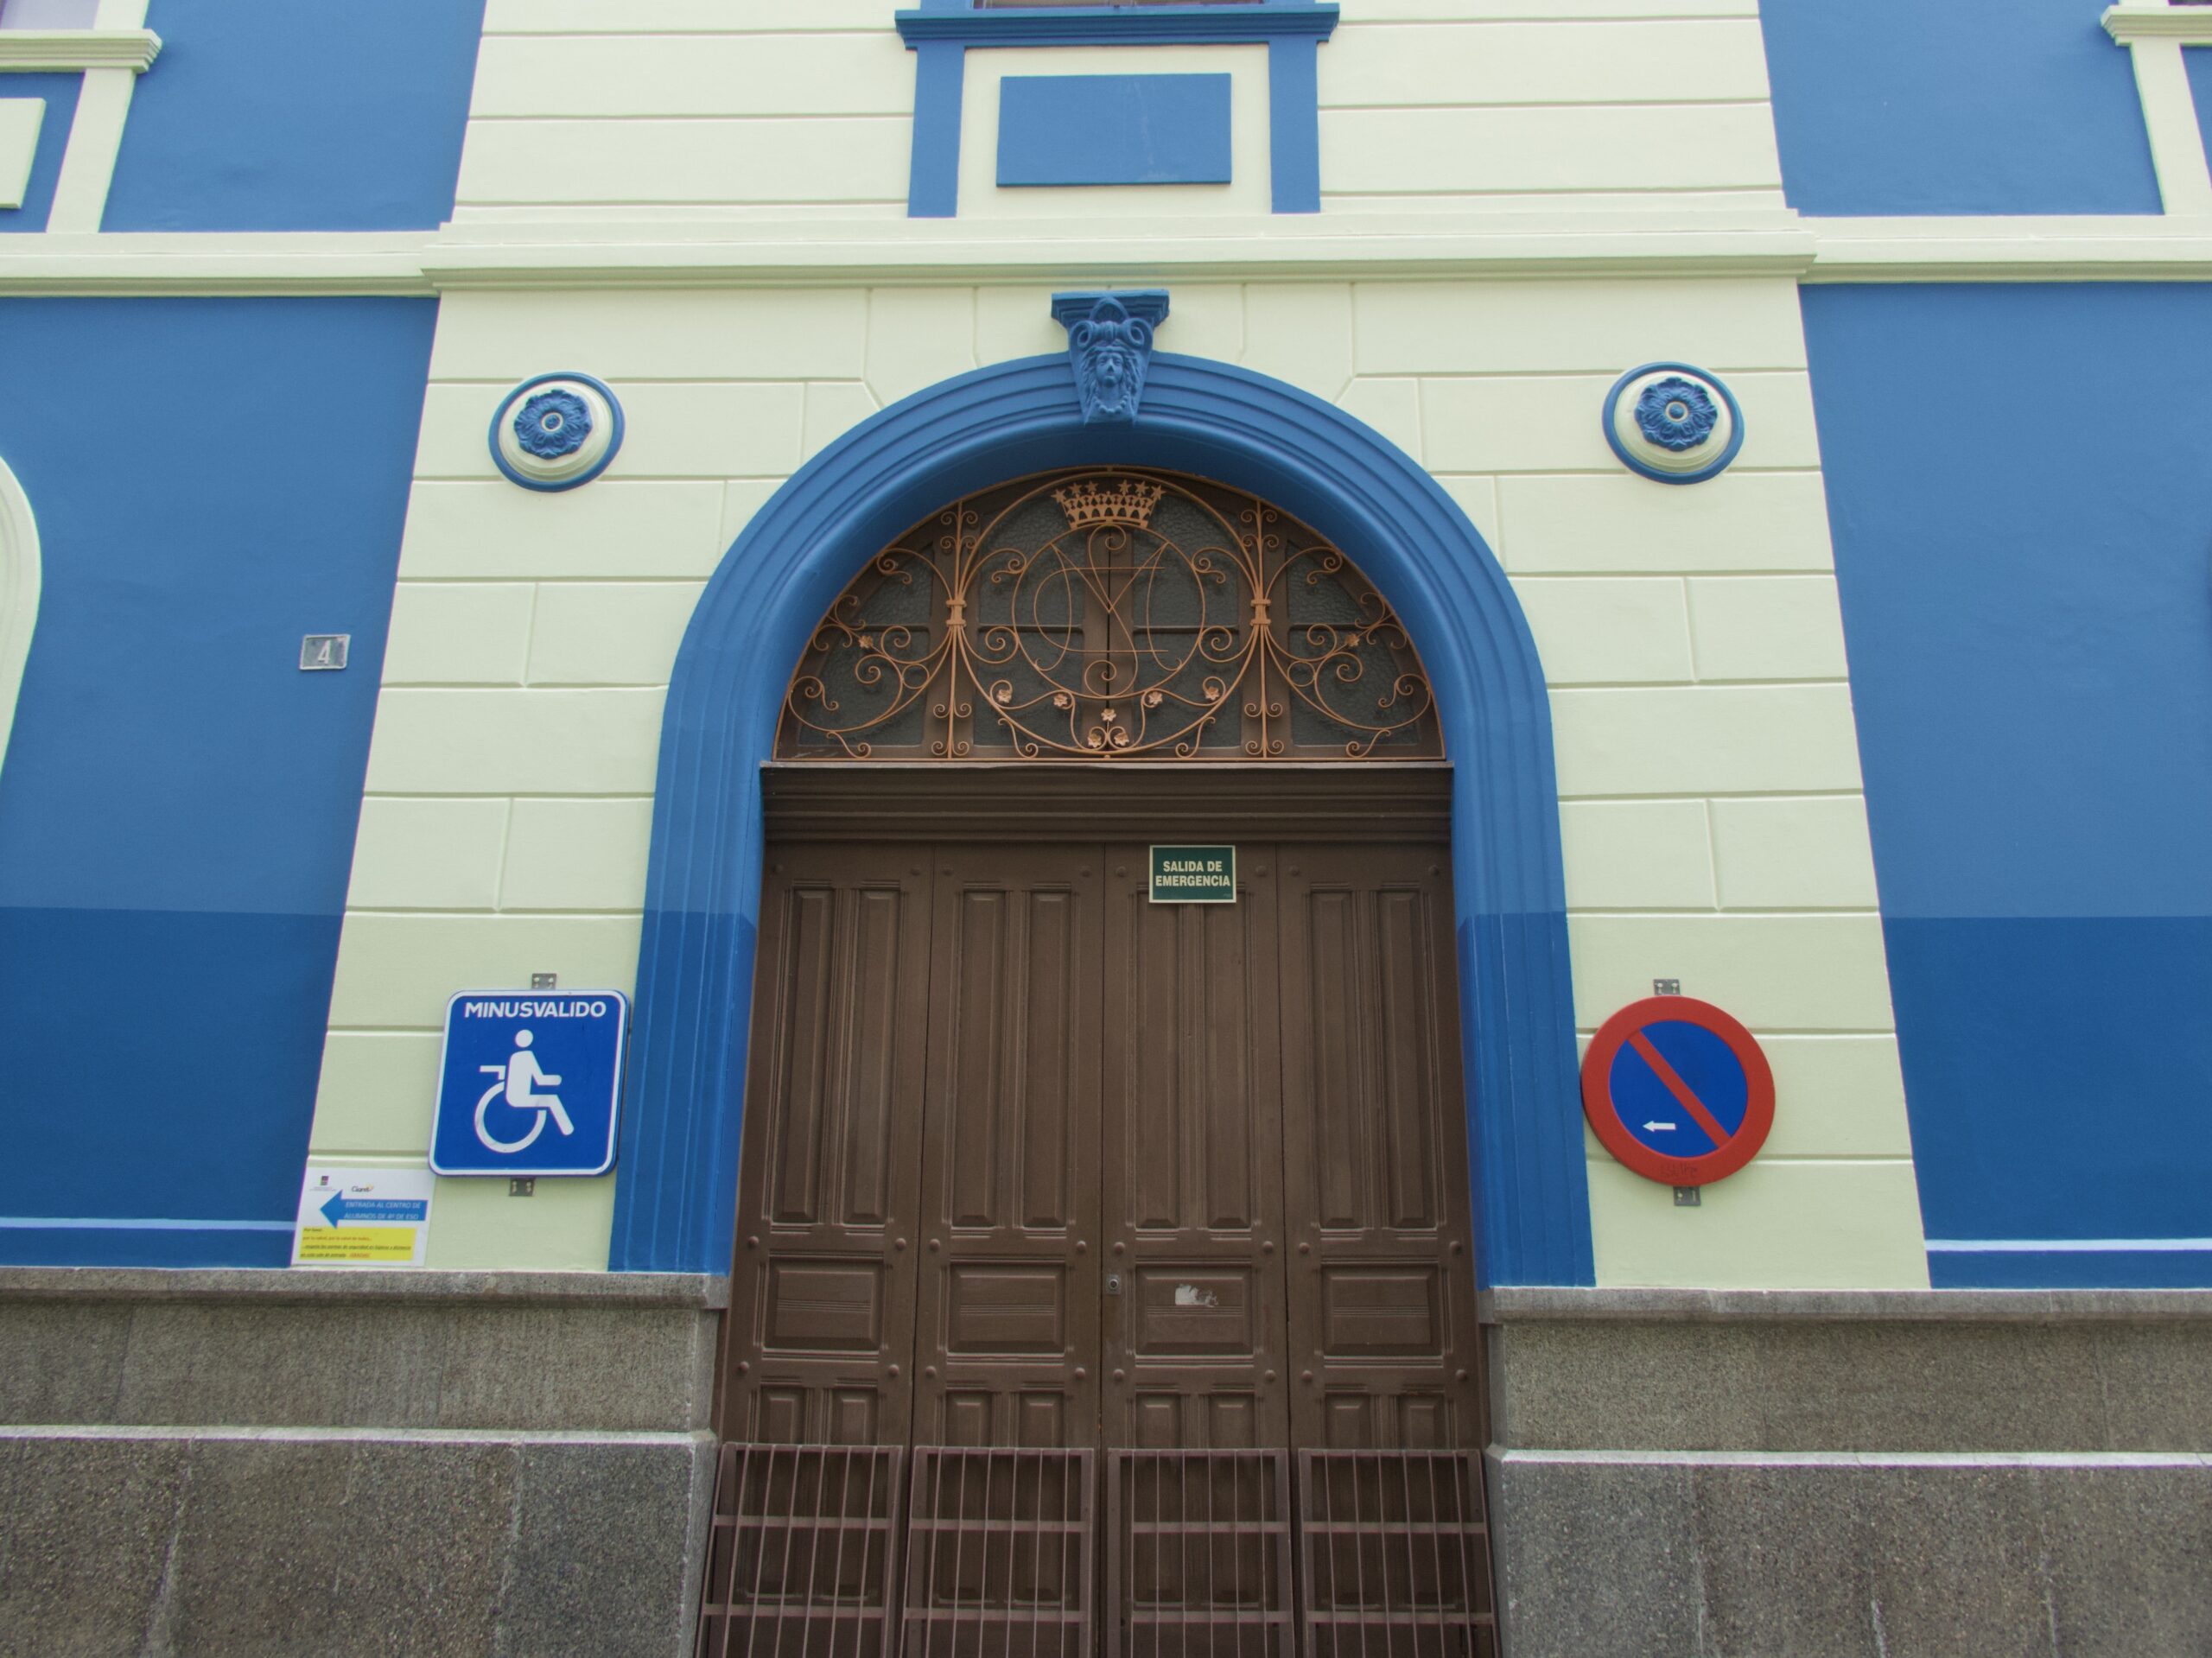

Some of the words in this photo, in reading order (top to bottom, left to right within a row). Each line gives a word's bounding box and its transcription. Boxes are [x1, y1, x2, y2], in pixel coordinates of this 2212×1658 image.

[317, 639, 330, 664] 4
[1163, 861, 1205, 873] SALIDA
[1207, 861, 1223, 873] DE
[1155, 875, 1231, 887] EMERGENCIA
[464, 1001, 607, 1019] MINUSVALIDO
